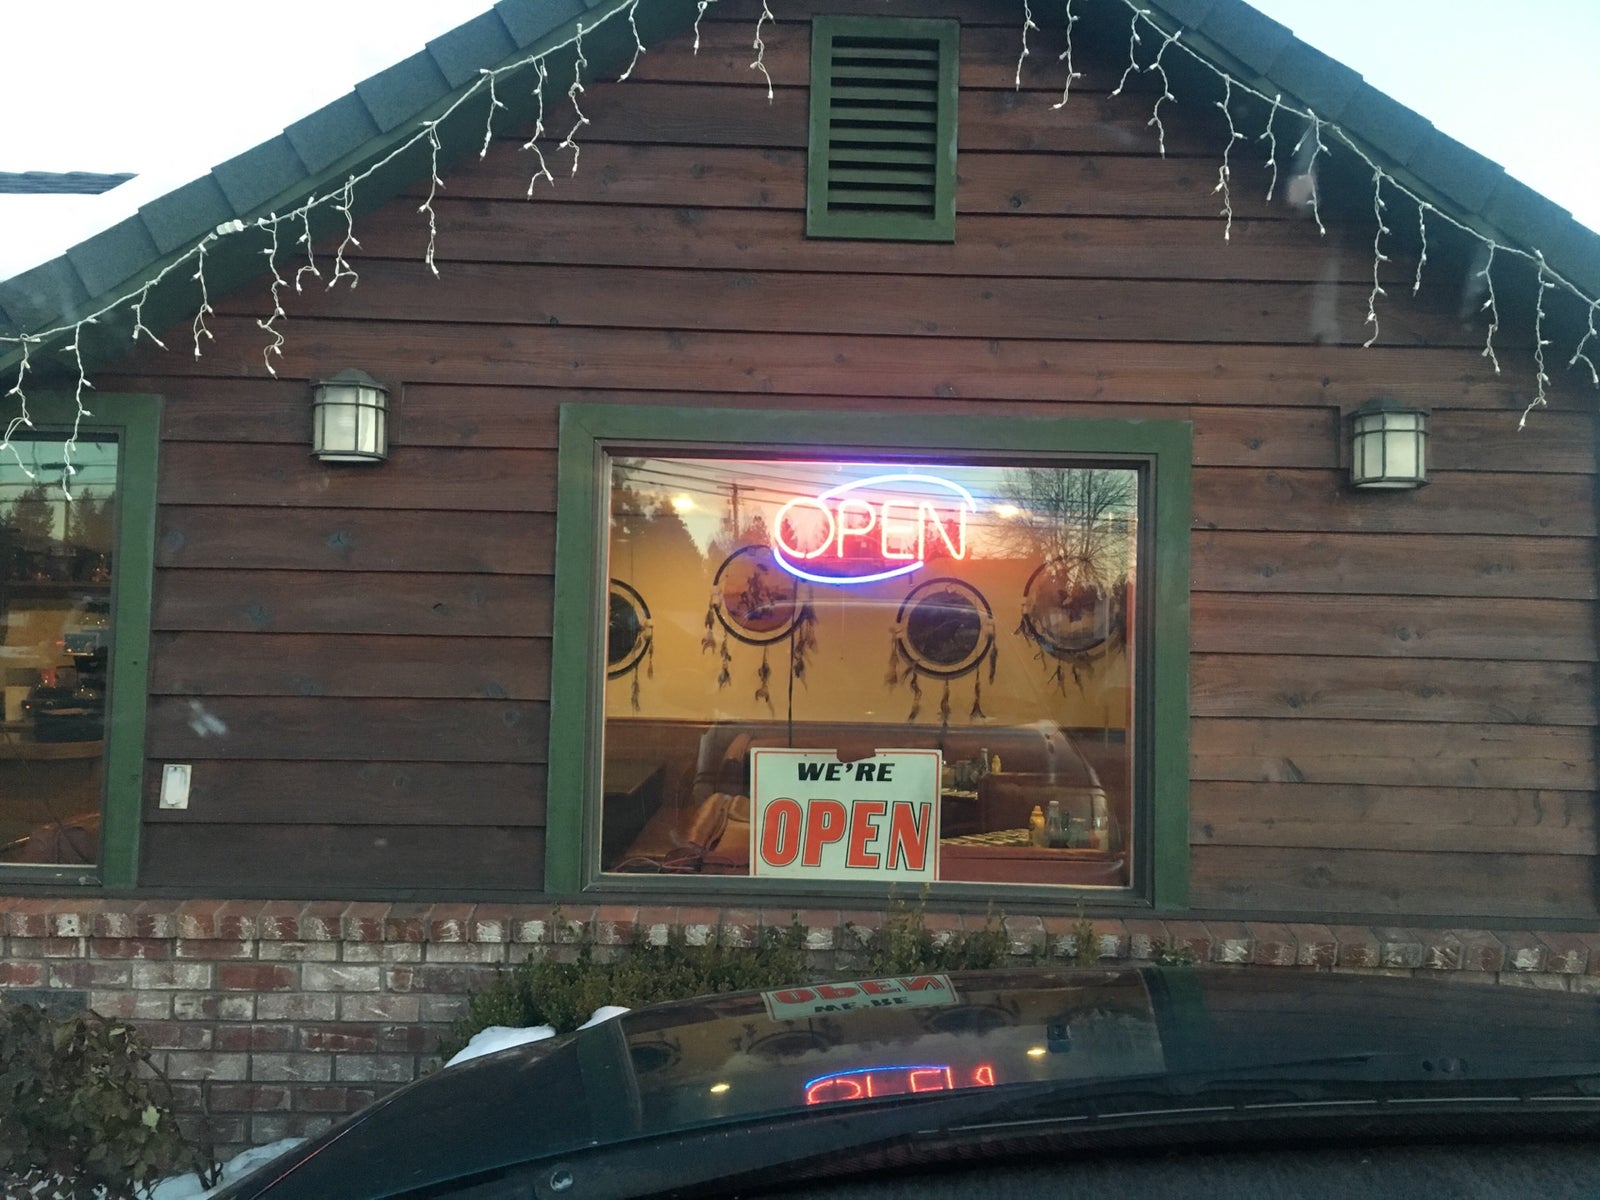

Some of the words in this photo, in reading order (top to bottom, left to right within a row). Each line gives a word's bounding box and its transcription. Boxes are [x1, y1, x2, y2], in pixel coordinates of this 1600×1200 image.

[774, 498, 968, 561] OPEN
[798, 762, 895, 782] WE'RE
[761, 798, 932, 871] OPEN
